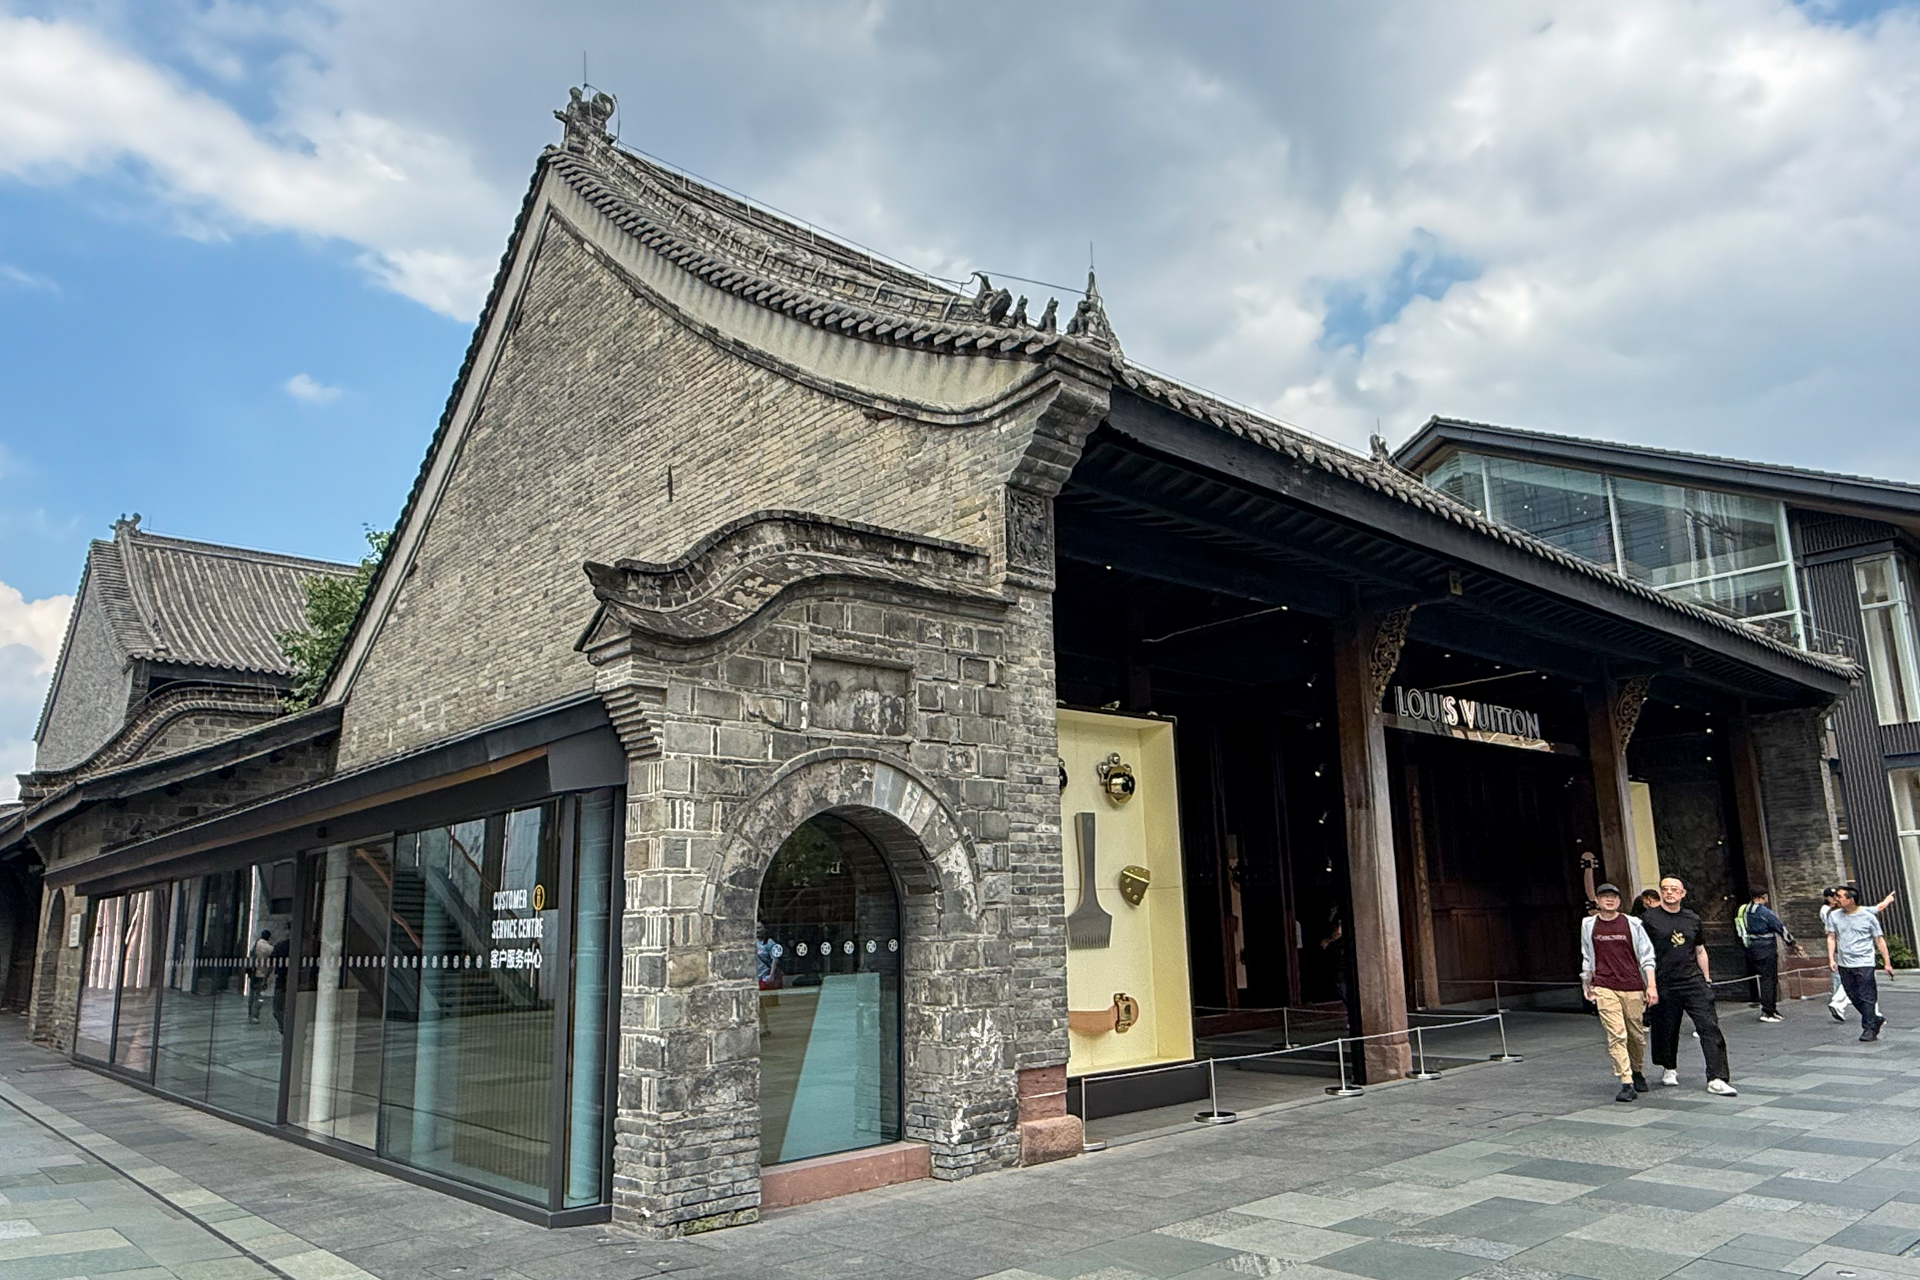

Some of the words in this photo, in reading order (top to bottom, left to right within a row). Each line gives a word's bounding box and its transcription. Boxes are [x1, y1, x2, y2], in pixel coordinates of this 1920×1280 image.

[1395, 686, 1458, 726] LOUIS
[1459, 699, 1540, 739] VUITTON
[493, 889, 528, 911] CUSTOMER
[491, 919, 517, 939] SERVICE
[518, 918, 544, 938] CENTRE
[490, 948, 542, 969] 客户服务中心
